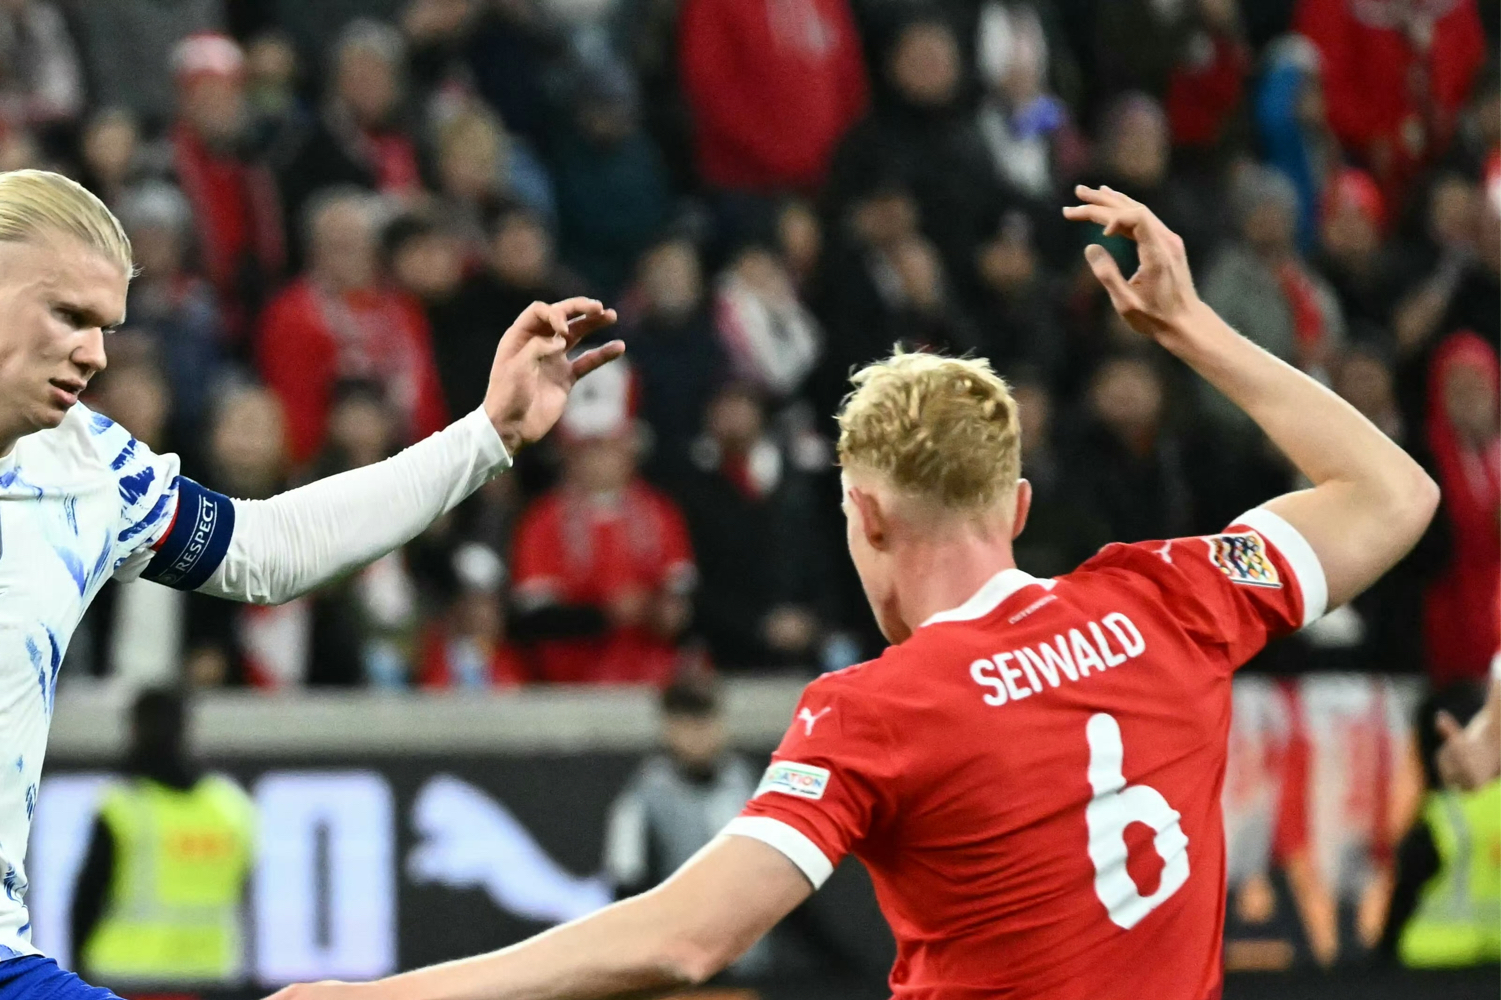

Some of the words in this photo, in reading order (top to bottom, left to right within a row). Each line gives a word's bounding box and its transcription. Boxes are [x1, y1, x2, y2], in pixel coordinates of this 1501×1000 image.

[176, 496, 214, 572] RESPECT
[969, 612, 1146, 707] SEIWALD
[1086, 713, 1189, 930] 6
